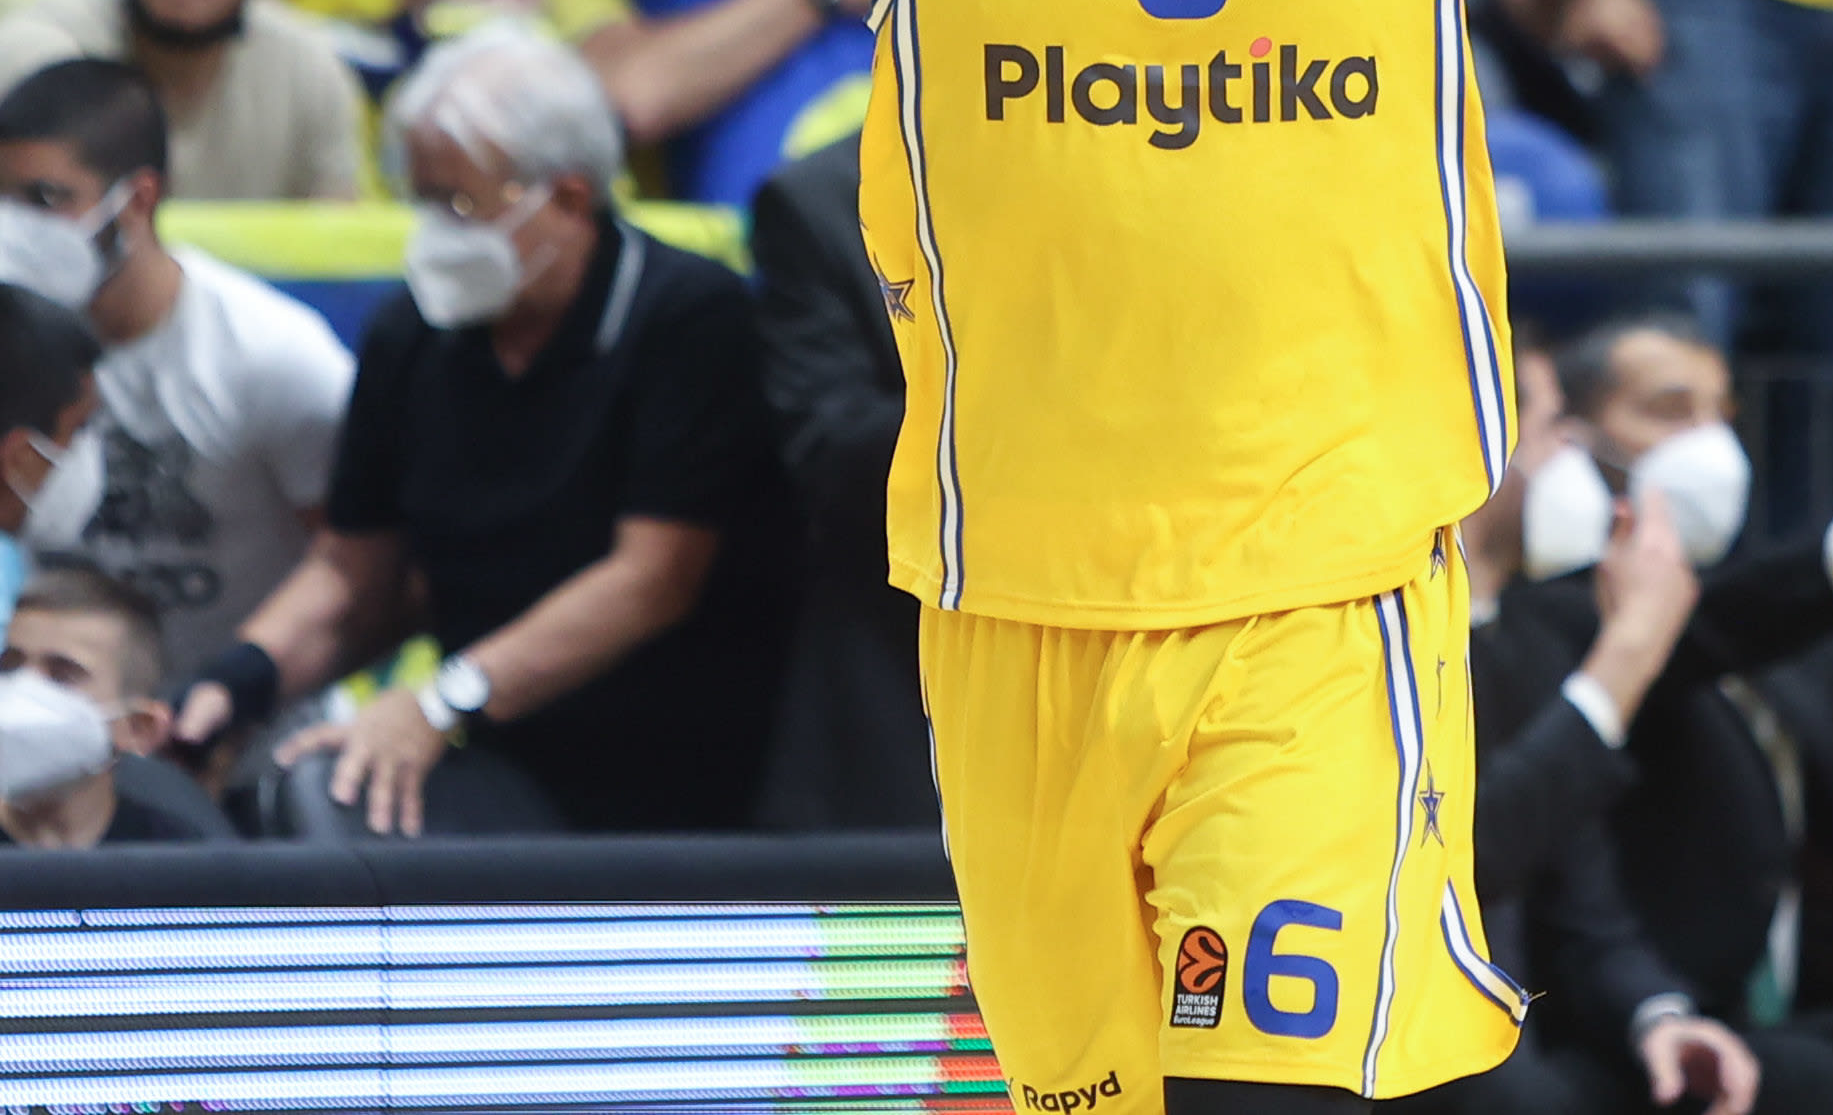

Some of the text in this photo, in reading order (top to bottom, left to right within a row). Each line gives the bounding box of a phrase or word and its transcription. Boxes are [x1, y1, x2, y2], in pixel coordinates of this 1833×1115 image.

[984, 36, 1379, 150] Playtika
[1242, 898, 1343, 1039] 6
[1175, 1004, 1217, 1017] AIRLINES
[1176, 993, 1219, 1006] TURKISH
[1021, 1070, 1122, 1115] Rapyd
